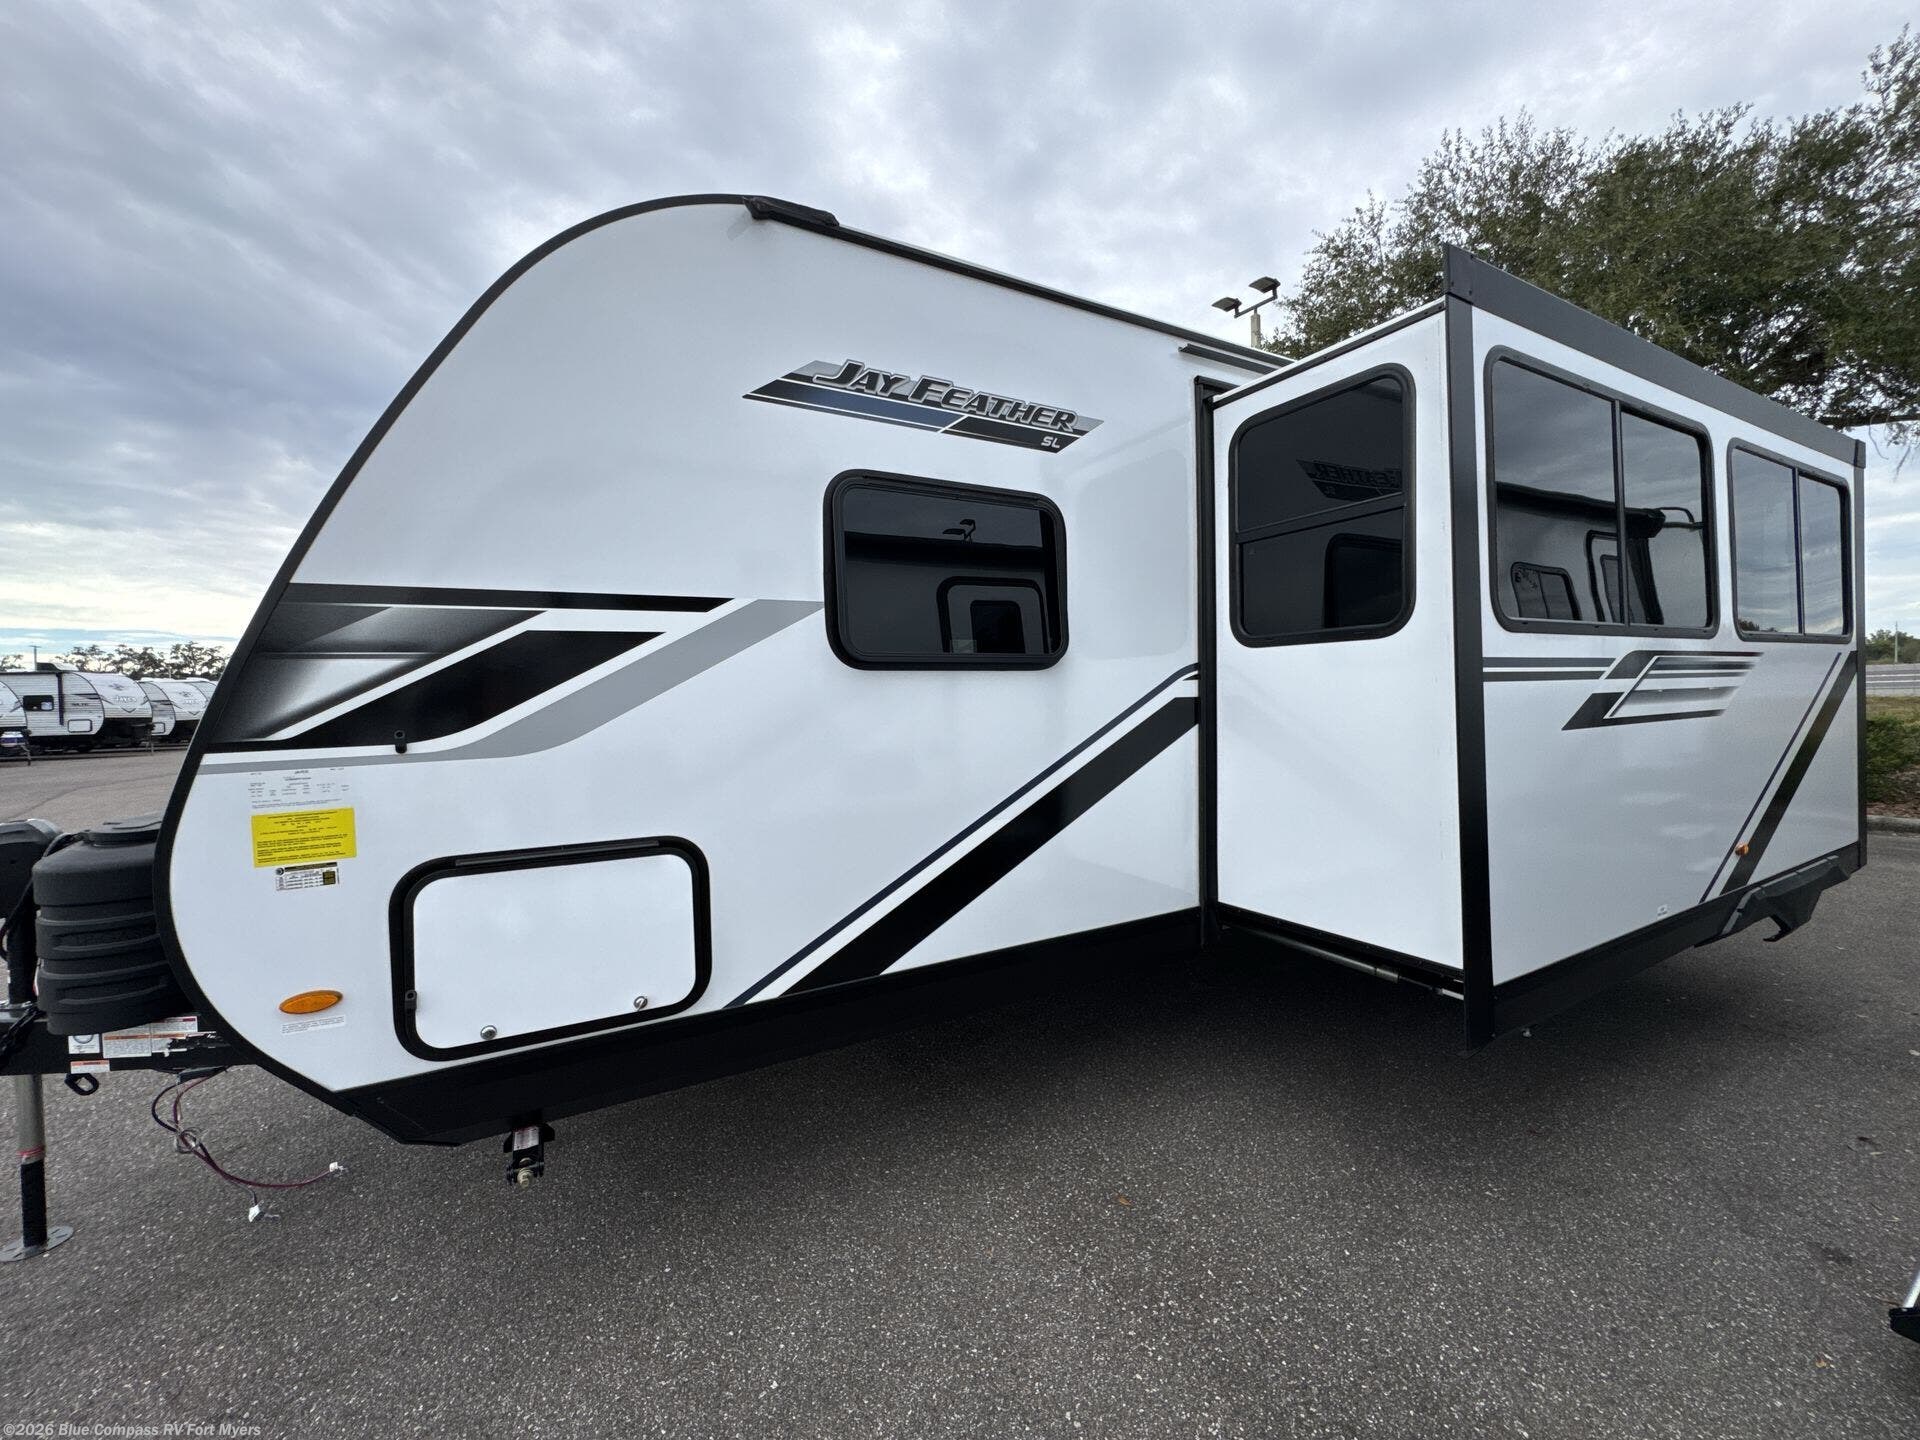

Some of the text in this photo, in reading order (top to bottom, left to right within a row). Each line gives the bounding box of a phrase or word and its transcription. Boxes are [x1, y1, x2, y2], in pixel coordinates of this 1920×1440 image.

[813, 359, 1079, 432] JAY FEATHER
[1041, 436, 1061, 449] SL
